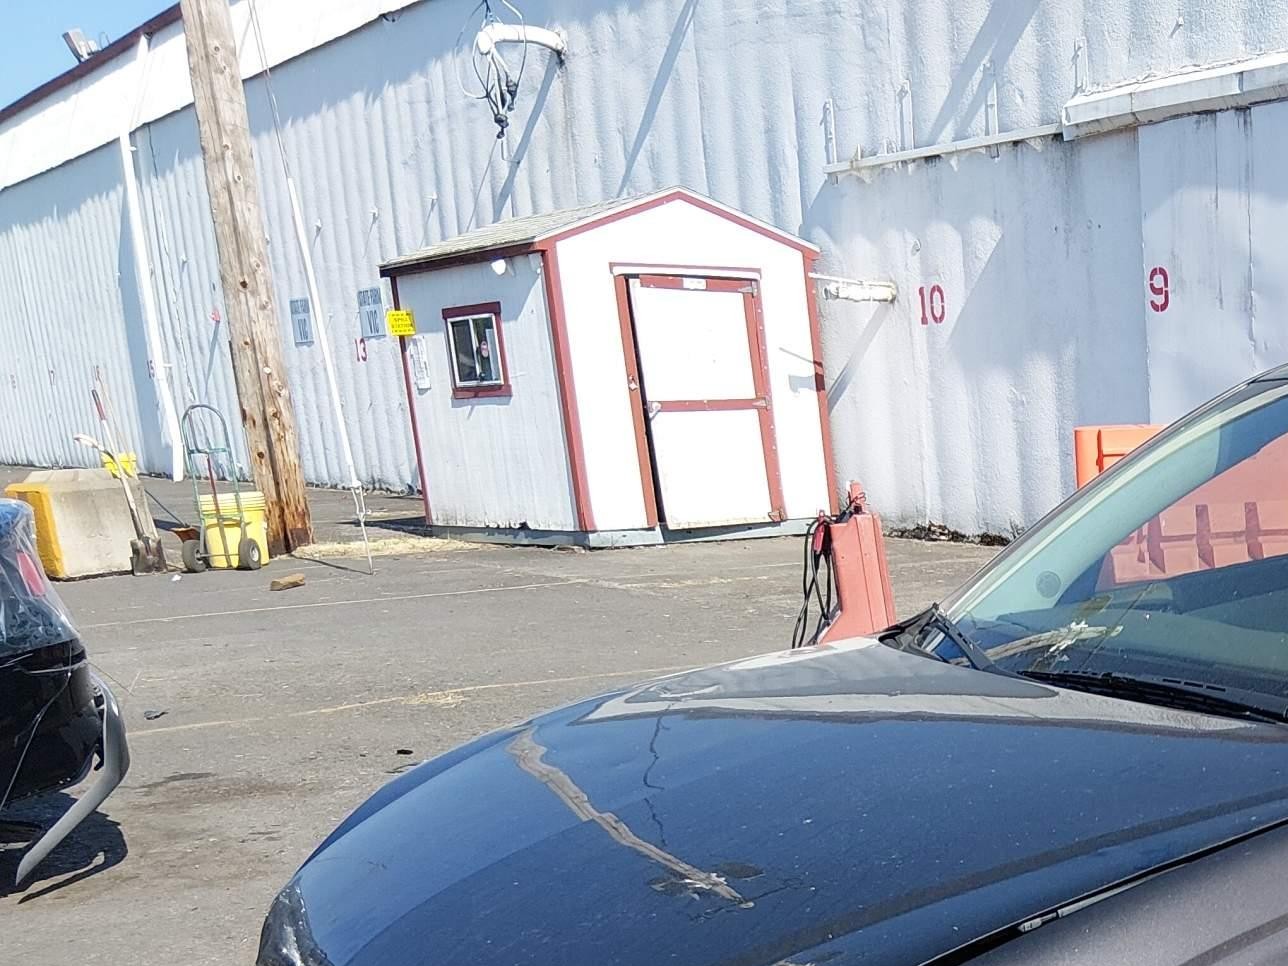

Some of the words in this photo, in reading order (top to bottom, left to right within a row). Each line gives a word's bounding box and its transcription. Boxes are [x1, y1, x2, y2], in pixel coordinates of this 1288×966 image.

[919, 285, 945, 325] 10
[1150, 267, 1169, 312] 9
[355, 338, 367, 361] 13
